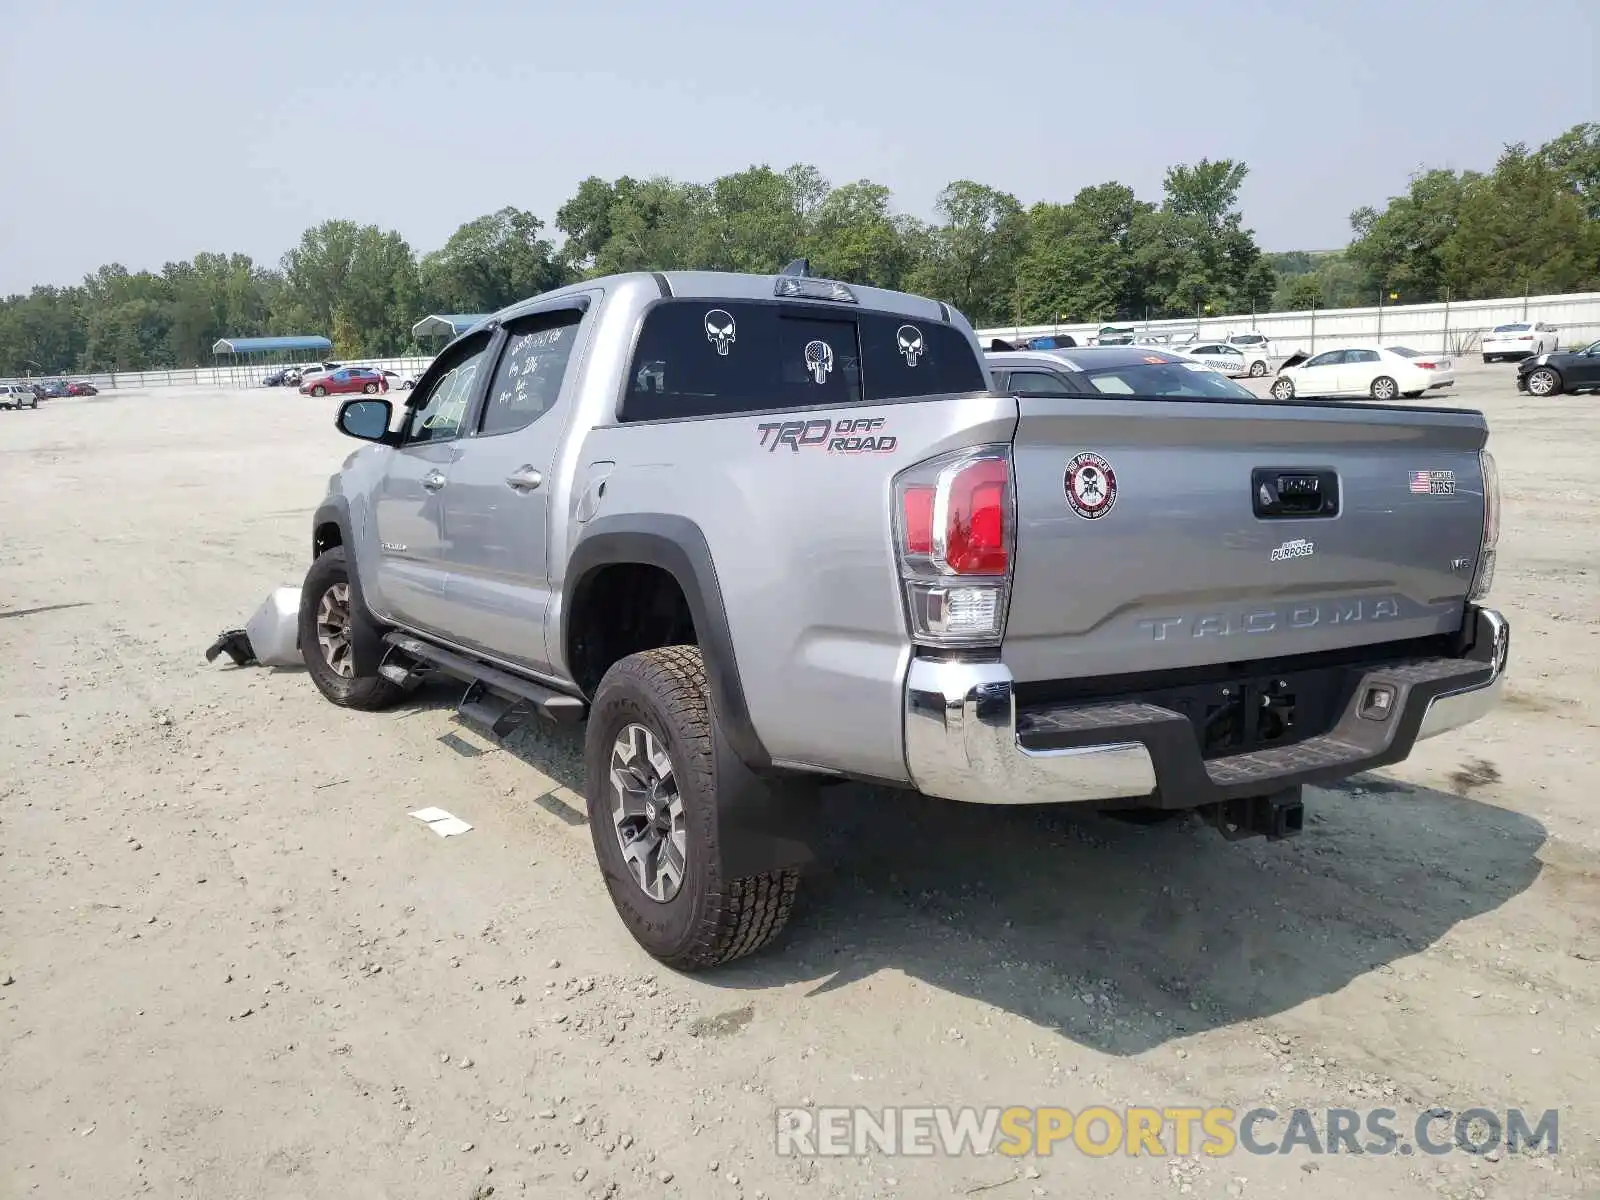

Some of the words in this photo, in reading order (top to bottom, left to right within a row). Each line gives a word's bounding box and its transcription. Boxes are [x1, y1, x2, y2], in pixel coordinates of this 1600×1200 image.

[834, 417, 886, 434] OFF
[757, 419, 832, 453] TRD
[827, 436, 898, 454] ROAD
[1429, 471, 1455, 480] AMERICA
[1430, 481, 1455, 494] FIRST
[1271, 543, 1314, 561] PURPOSE
[1138, 597, 1402, 641] TACOMA
